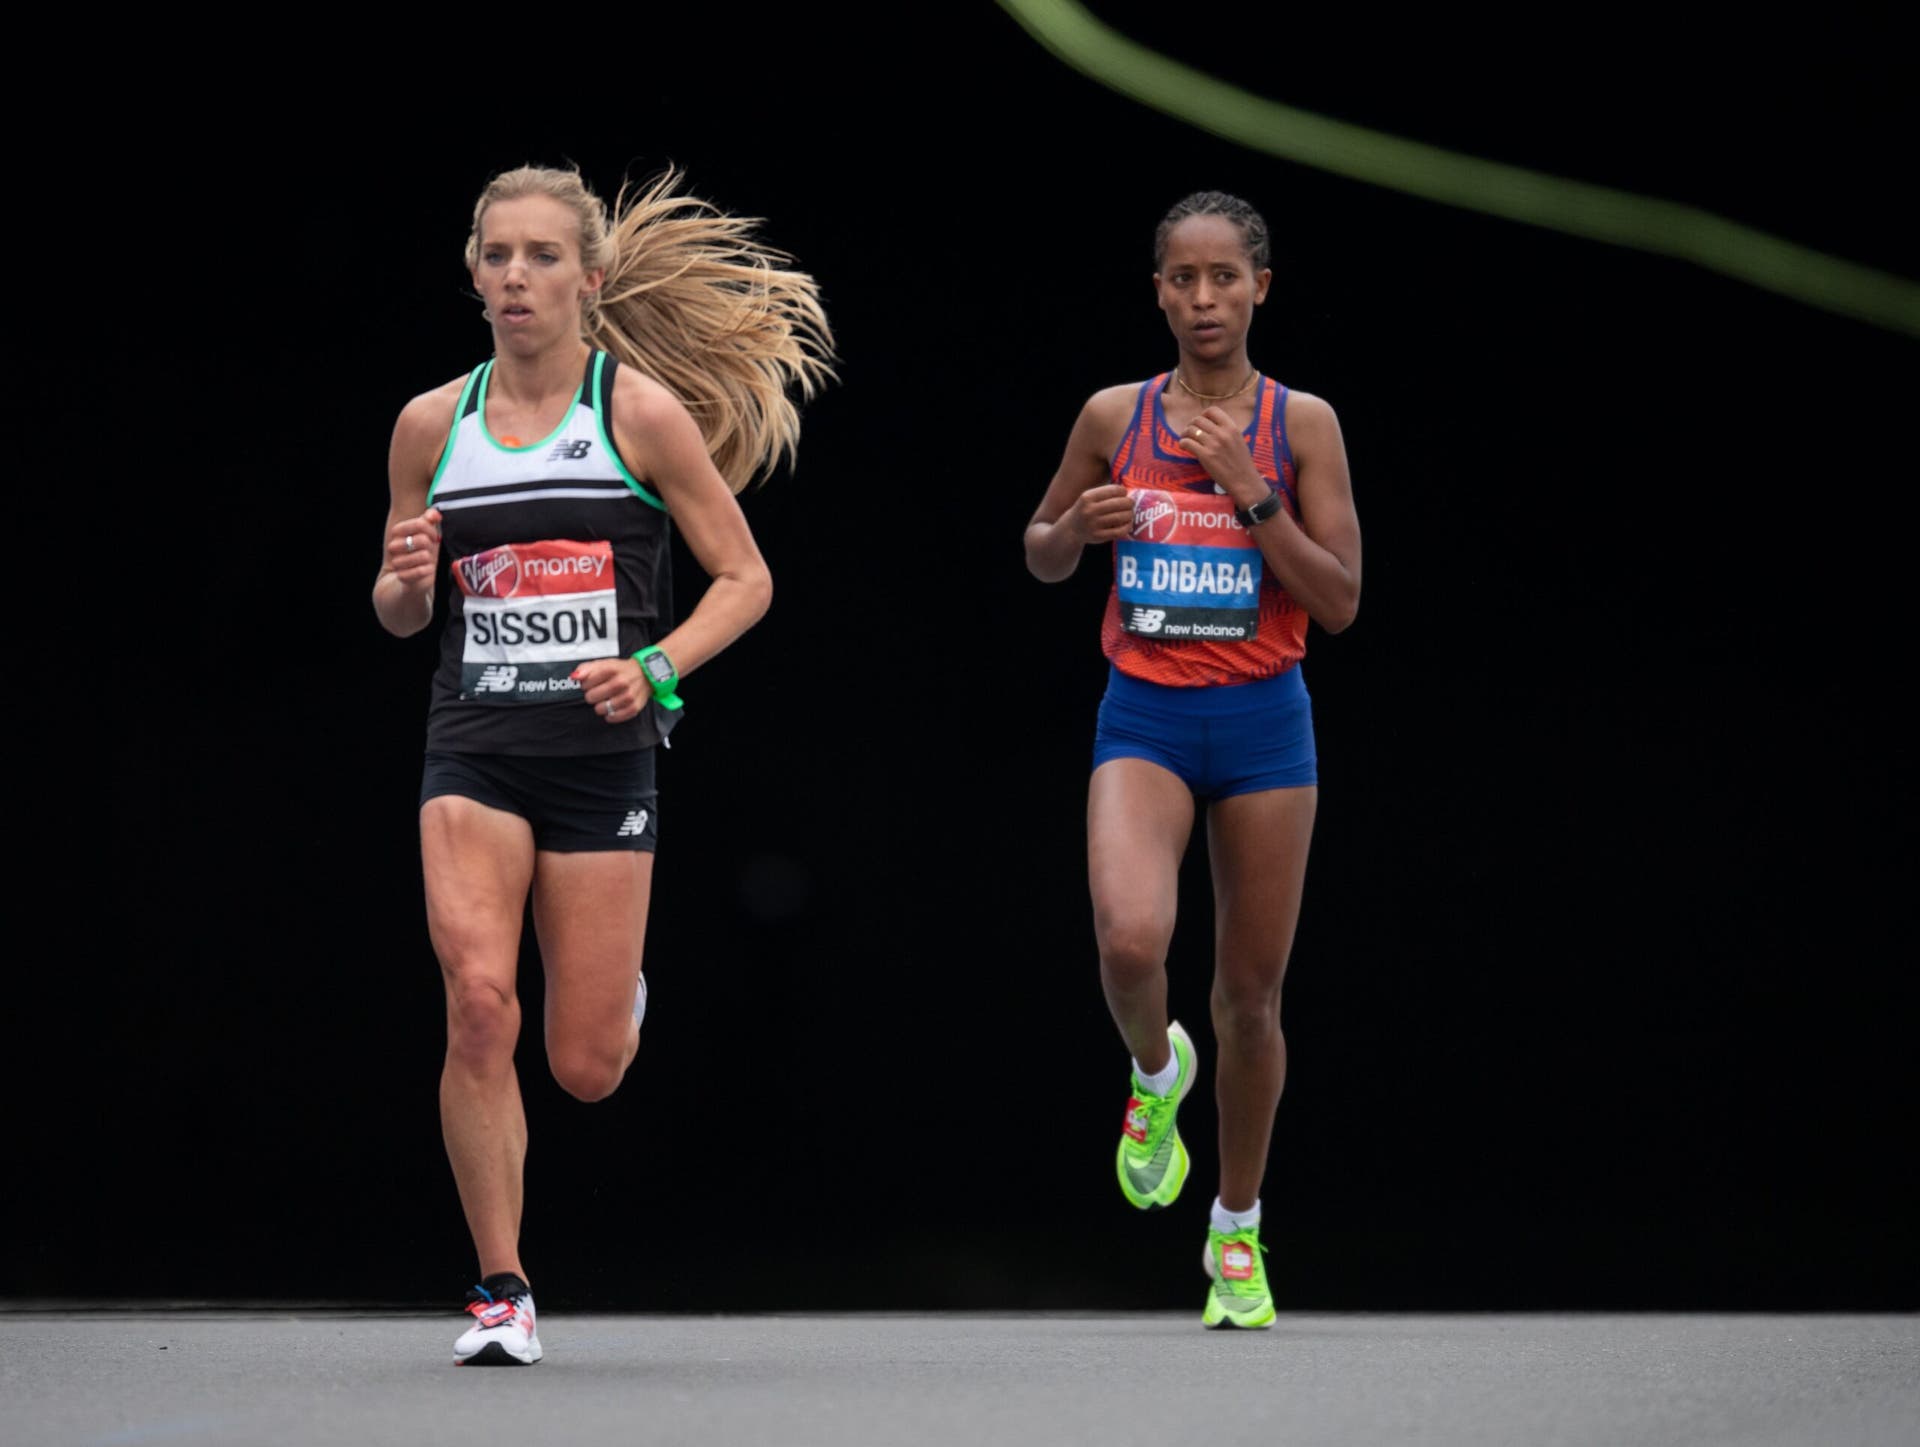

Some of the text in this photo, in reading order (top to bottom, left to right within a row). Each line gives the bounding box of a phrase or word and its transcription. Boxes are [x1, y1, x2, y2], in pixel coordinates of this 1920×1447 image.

[1181, 511, 1250, 535] mone
[464, 553, 607, 595] Virgin money
[1121, 556, 1254, 594] B. DIBABA
[472, 607, 608, 646] SISSON
[1165, 624, 1191, 635] new
[1193, 623, 1246, 637] balance
[519, 680, 547, 693] new
[548, 677, 582, 692] bala
